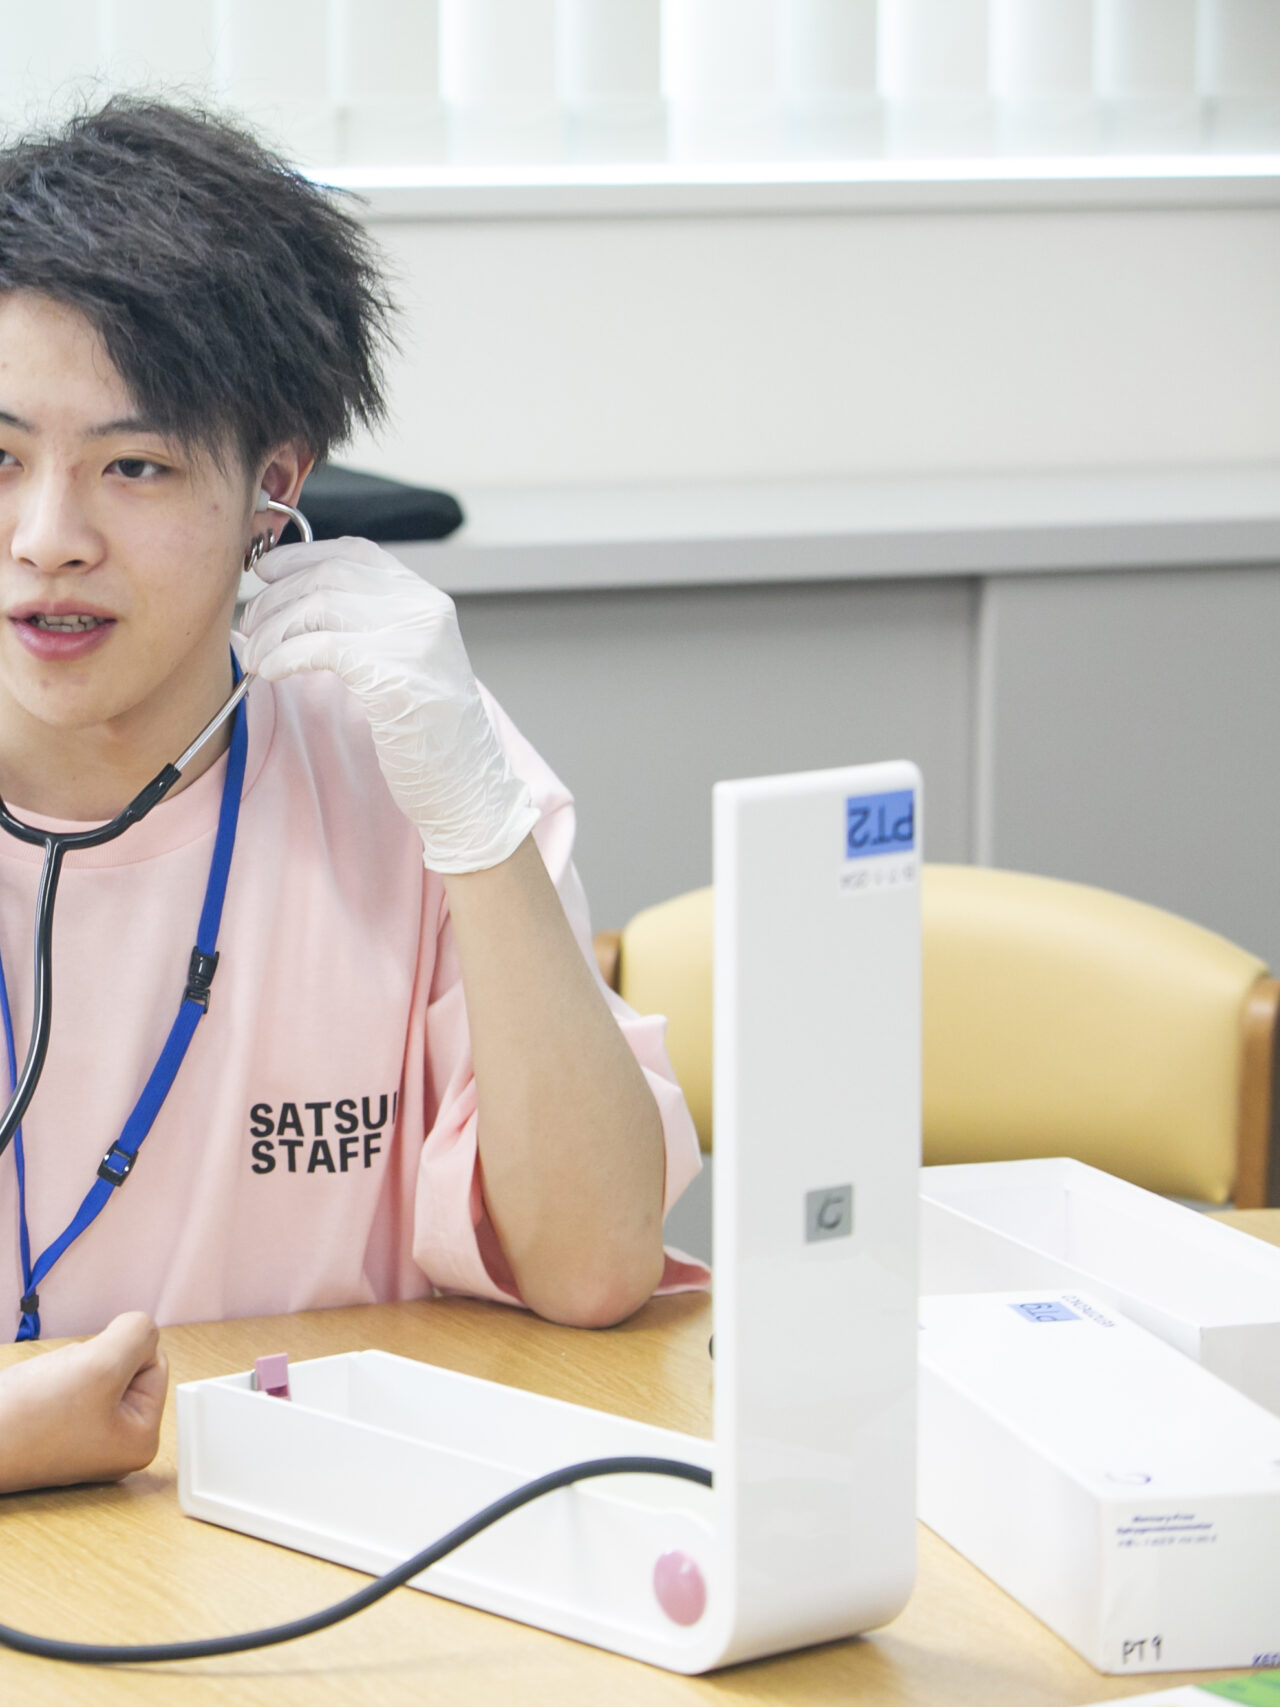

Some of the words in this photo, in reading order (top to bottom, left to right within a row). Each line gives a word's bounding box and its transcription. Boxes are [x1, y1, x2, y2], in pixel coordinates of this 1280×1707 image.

[847, 802, 914, 849] PT2
[249, 1091, 397, 1138] SATSU
[251, 1132, 382, 1175] STAFF
